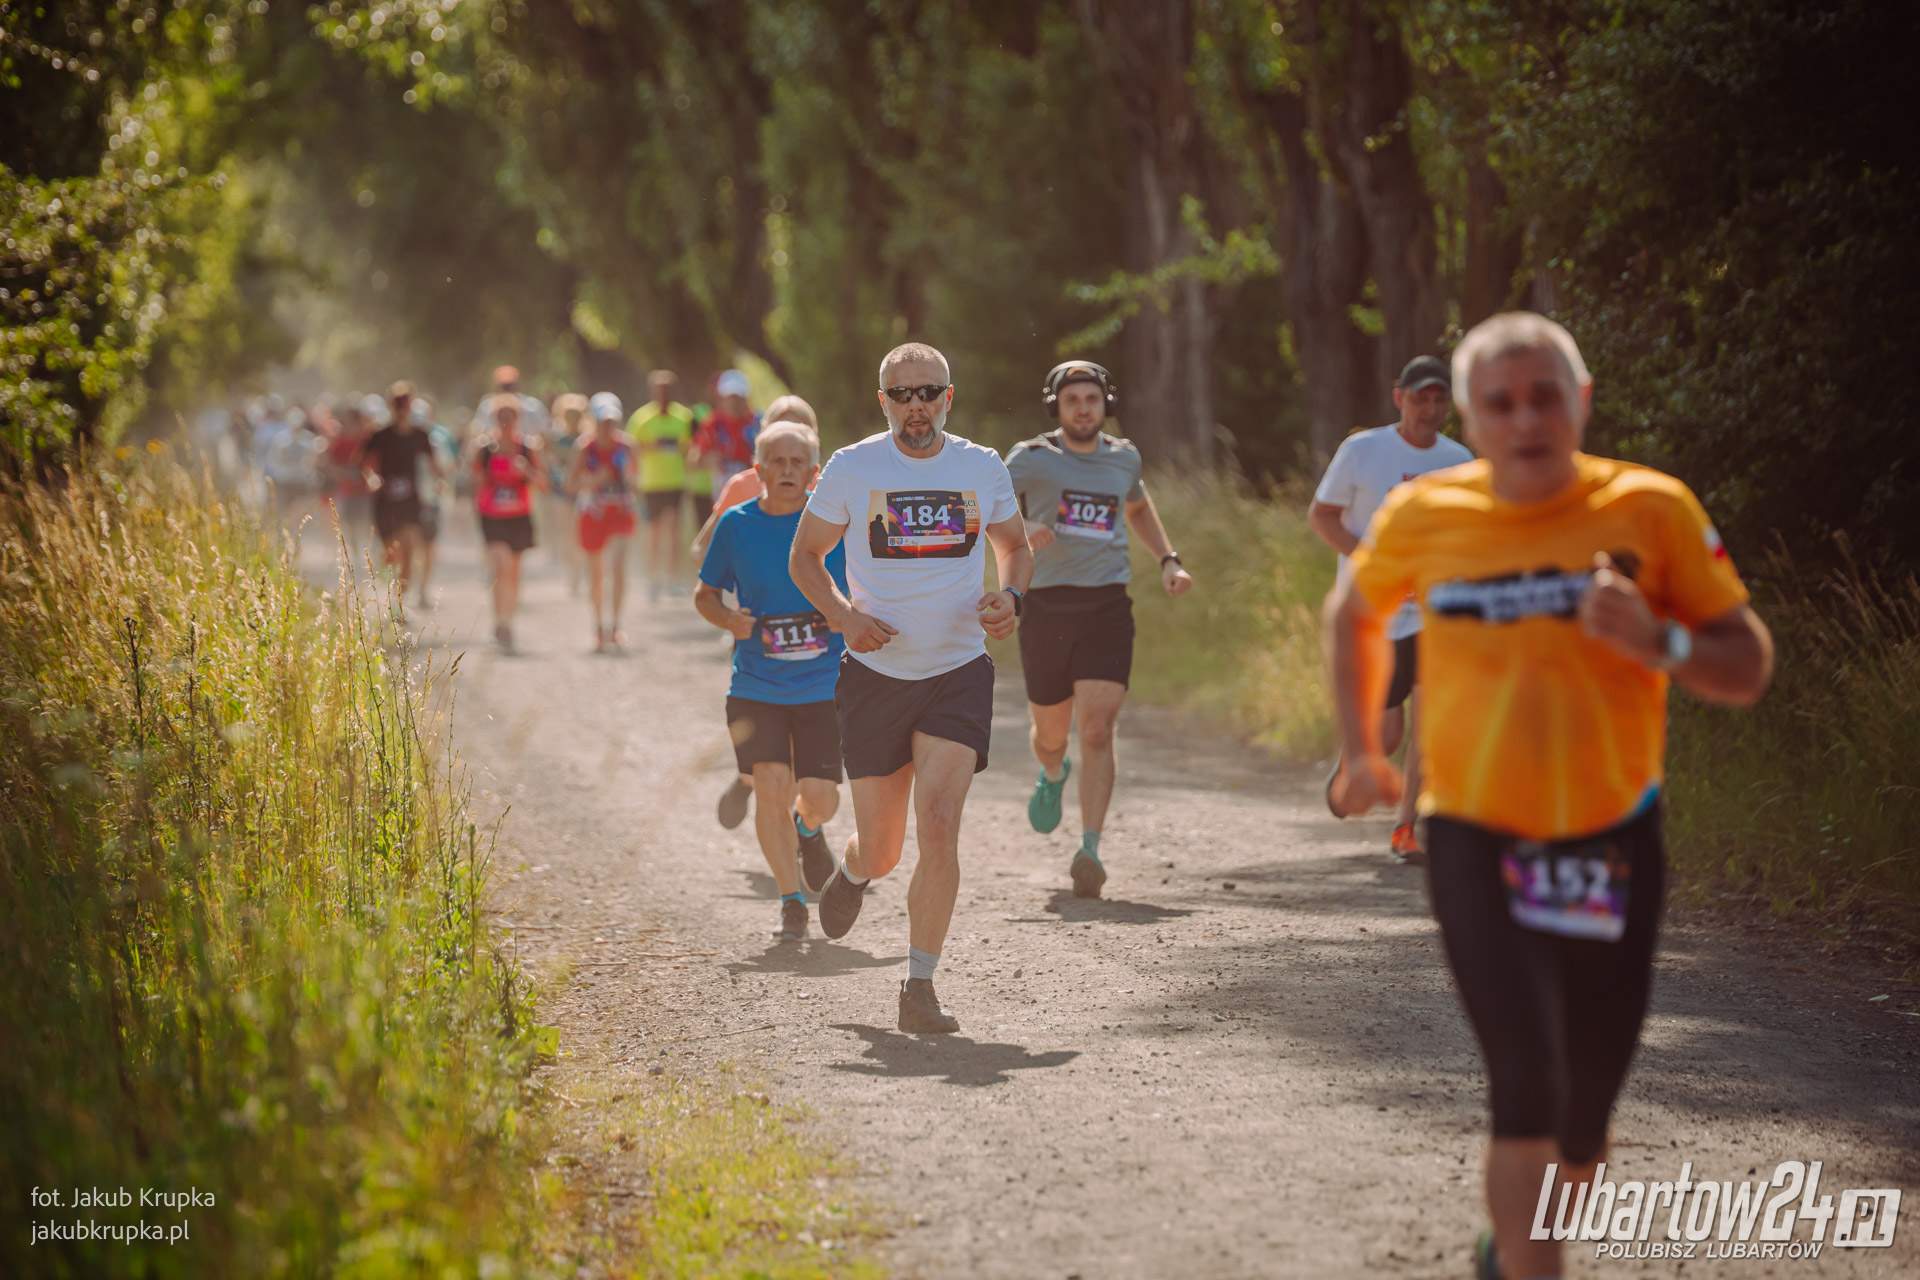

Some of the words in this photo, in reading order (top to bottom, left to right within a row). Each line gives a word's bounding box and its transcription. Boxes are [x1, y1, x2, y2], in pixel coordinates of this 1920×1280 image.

[902, 504, 951, 527] 184
[1071, 502, 1108, 523] 102
[774, 623, 817, 646] 111
[1529, 856, 1611, 900] 152
